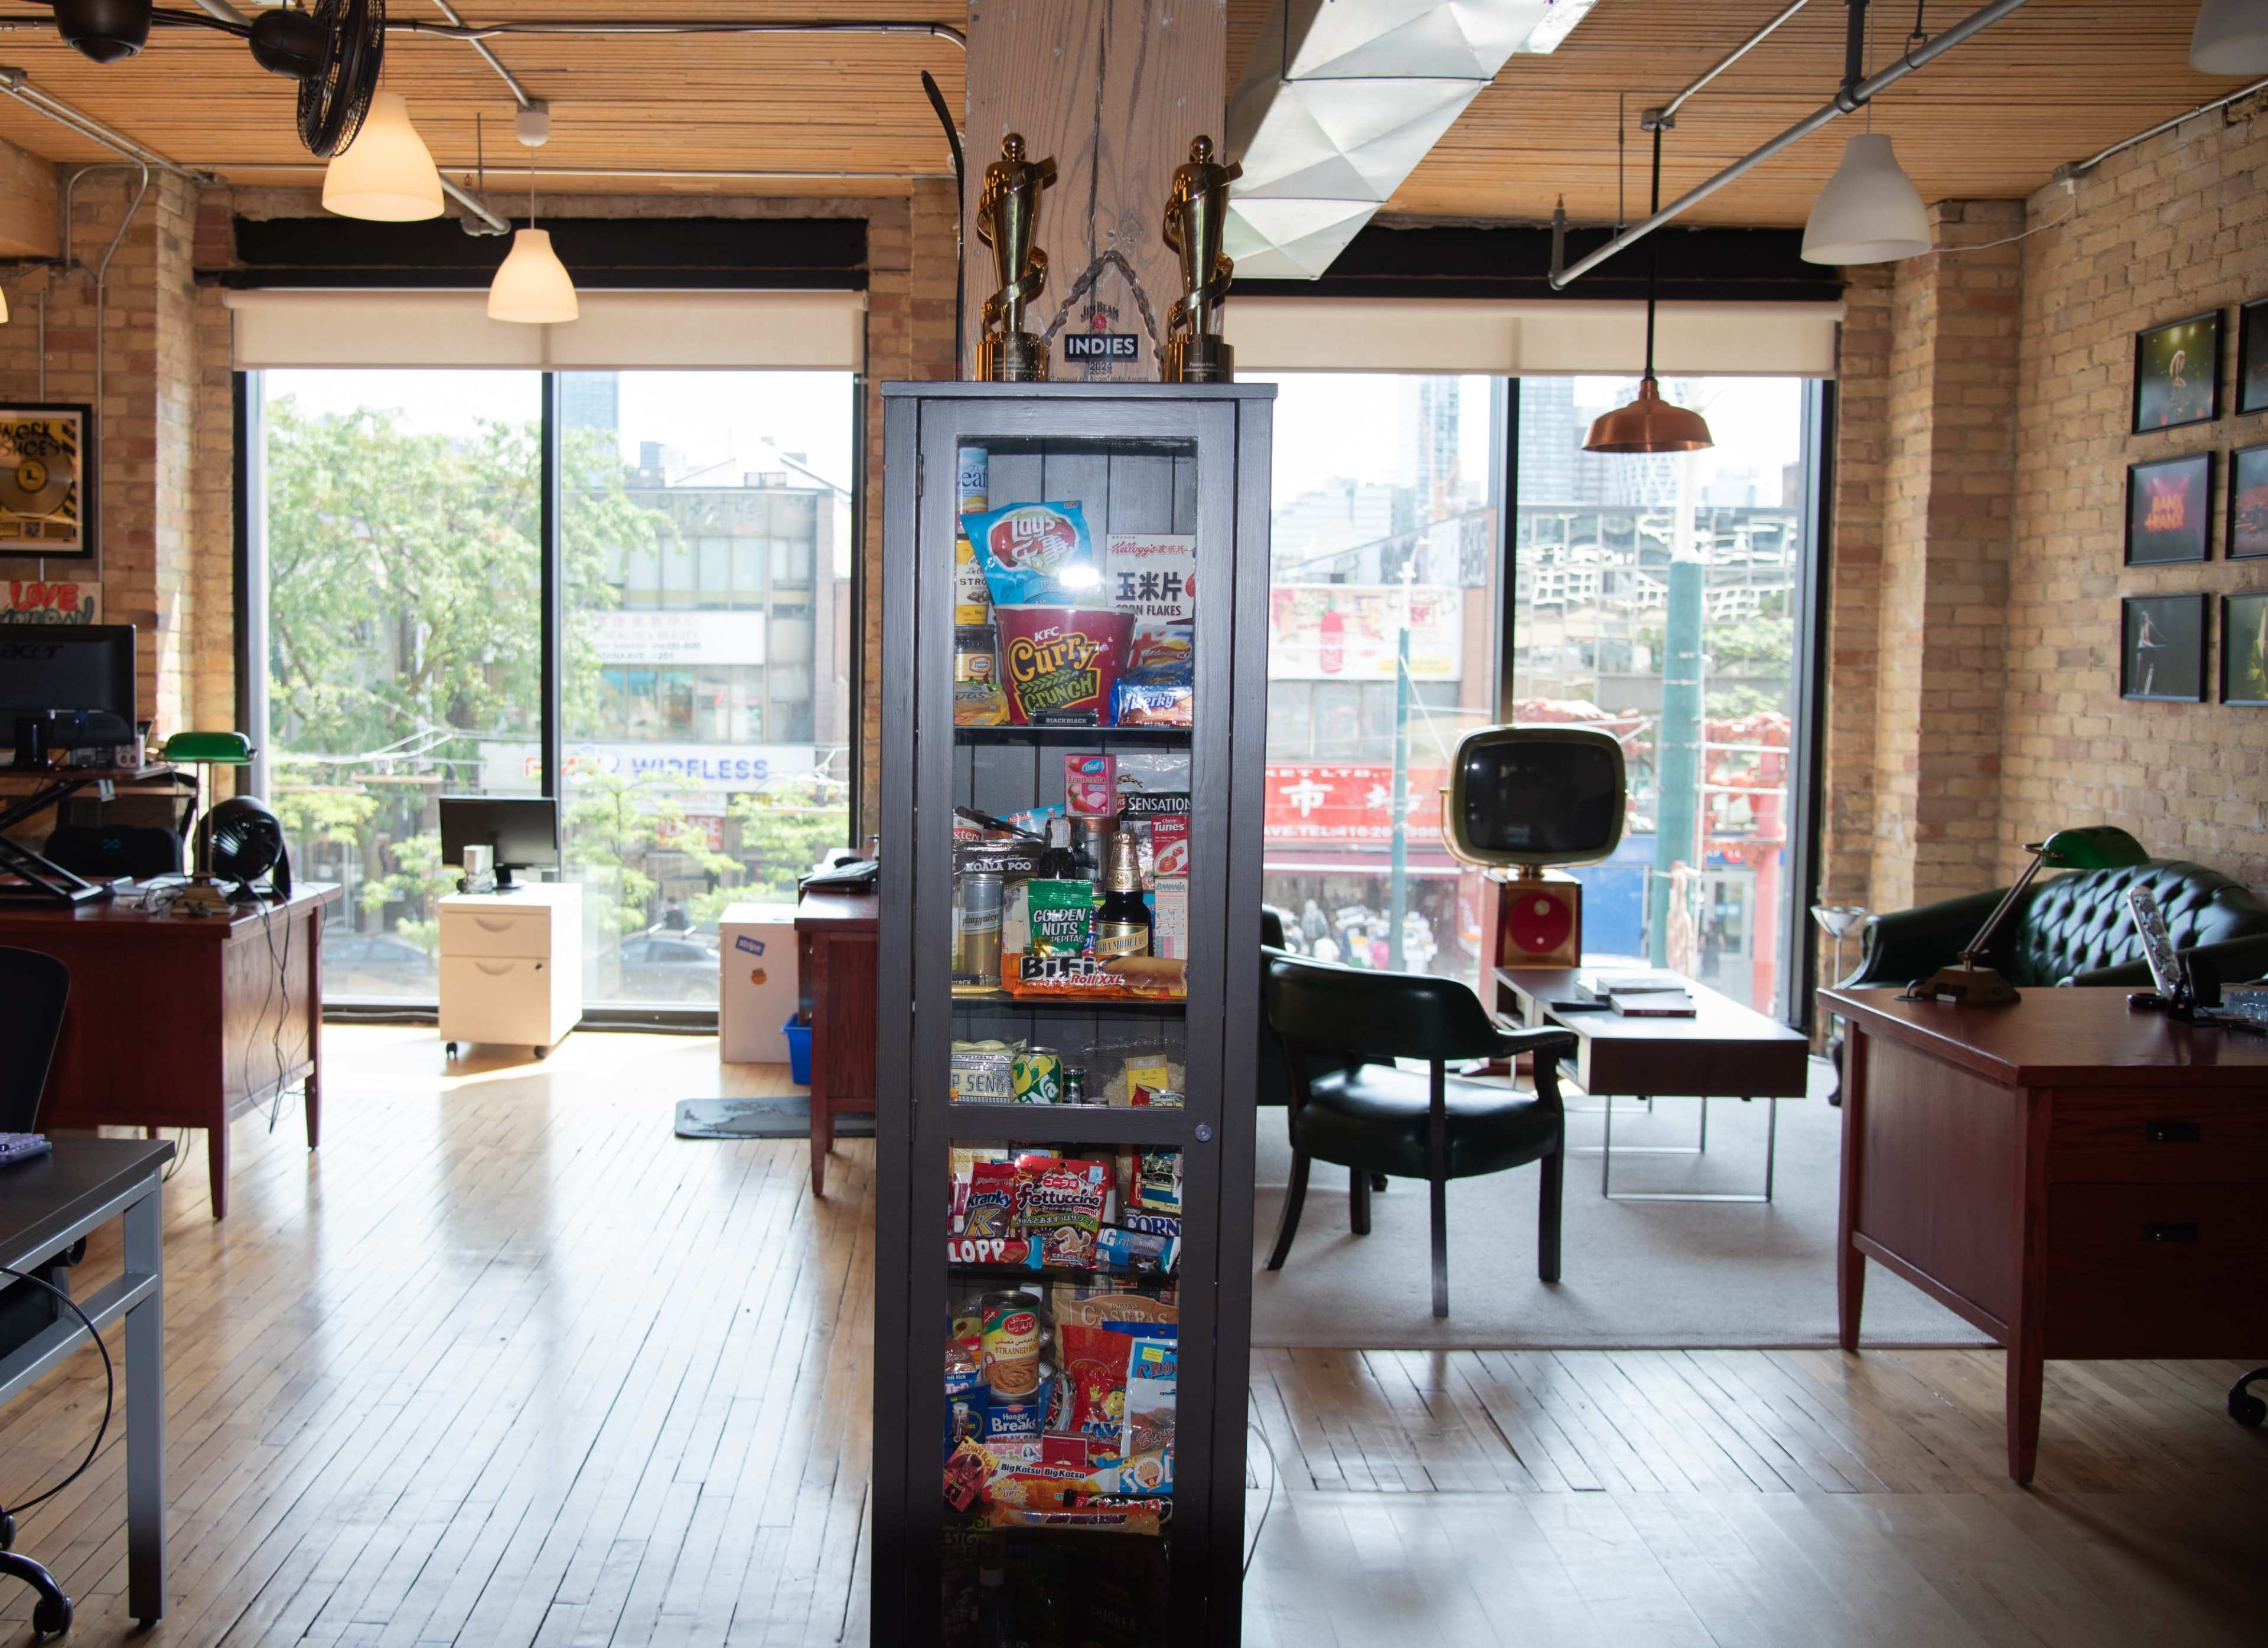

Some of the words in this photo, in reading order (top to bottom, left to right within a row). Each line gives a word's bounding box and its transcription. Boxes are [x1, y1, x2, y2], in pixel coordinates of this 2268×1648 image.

[1081, 305, 1095, 319] JIM
[1097, 302, 1118, 319] BEAM
[1069, 338, 1135, 354] INDIES
[1090, 362, 1112, 371] 2024
[962, 466, 988, 488] eaf
[1112, 540, 1156, 557] Kellogg's
[1116, 572, 1181, 601] 玉米片
[11, 580, 79, 611] LOVE
[1147, 605, 1181, 616] FLAKES
[1034, 626, 1060, 642] KFC
[1, 644, 64, 660] acer
[1011, 637, 1093, 681] Curry
[1153, 821, 1185, 831] Tunes
[966, 861, 1004, 872] KOALA
[1008, 861, 1031, 871] POO
[1156, 882, 1185, 891] BANANIA
[1033, 908, 1086, 922] GOLDEN
[1041, 921, 1078, 936] NUTS
[739, 938, 761, 953] stripe
[1051, 935, 1083, 944] PEPITAS
[1113, 935, 1143, 950] MODELO
[1022, 957, 1095, 978] BiFi
[1070, 974, 1096, 984] Roll
[1099, 975, 1123, 984] XXL
[967, 1075, 1005, 1093] SENG
[967, 1190, 1011, 1208] Kranky
[1016, 1182, 1102, 1210] fettuccine
[1074, 1206, 1097, 1216] gummi
[995, 1346, 1028, 1355] STRAINED
[1002, 1413, 1028, 1422] Hunger
